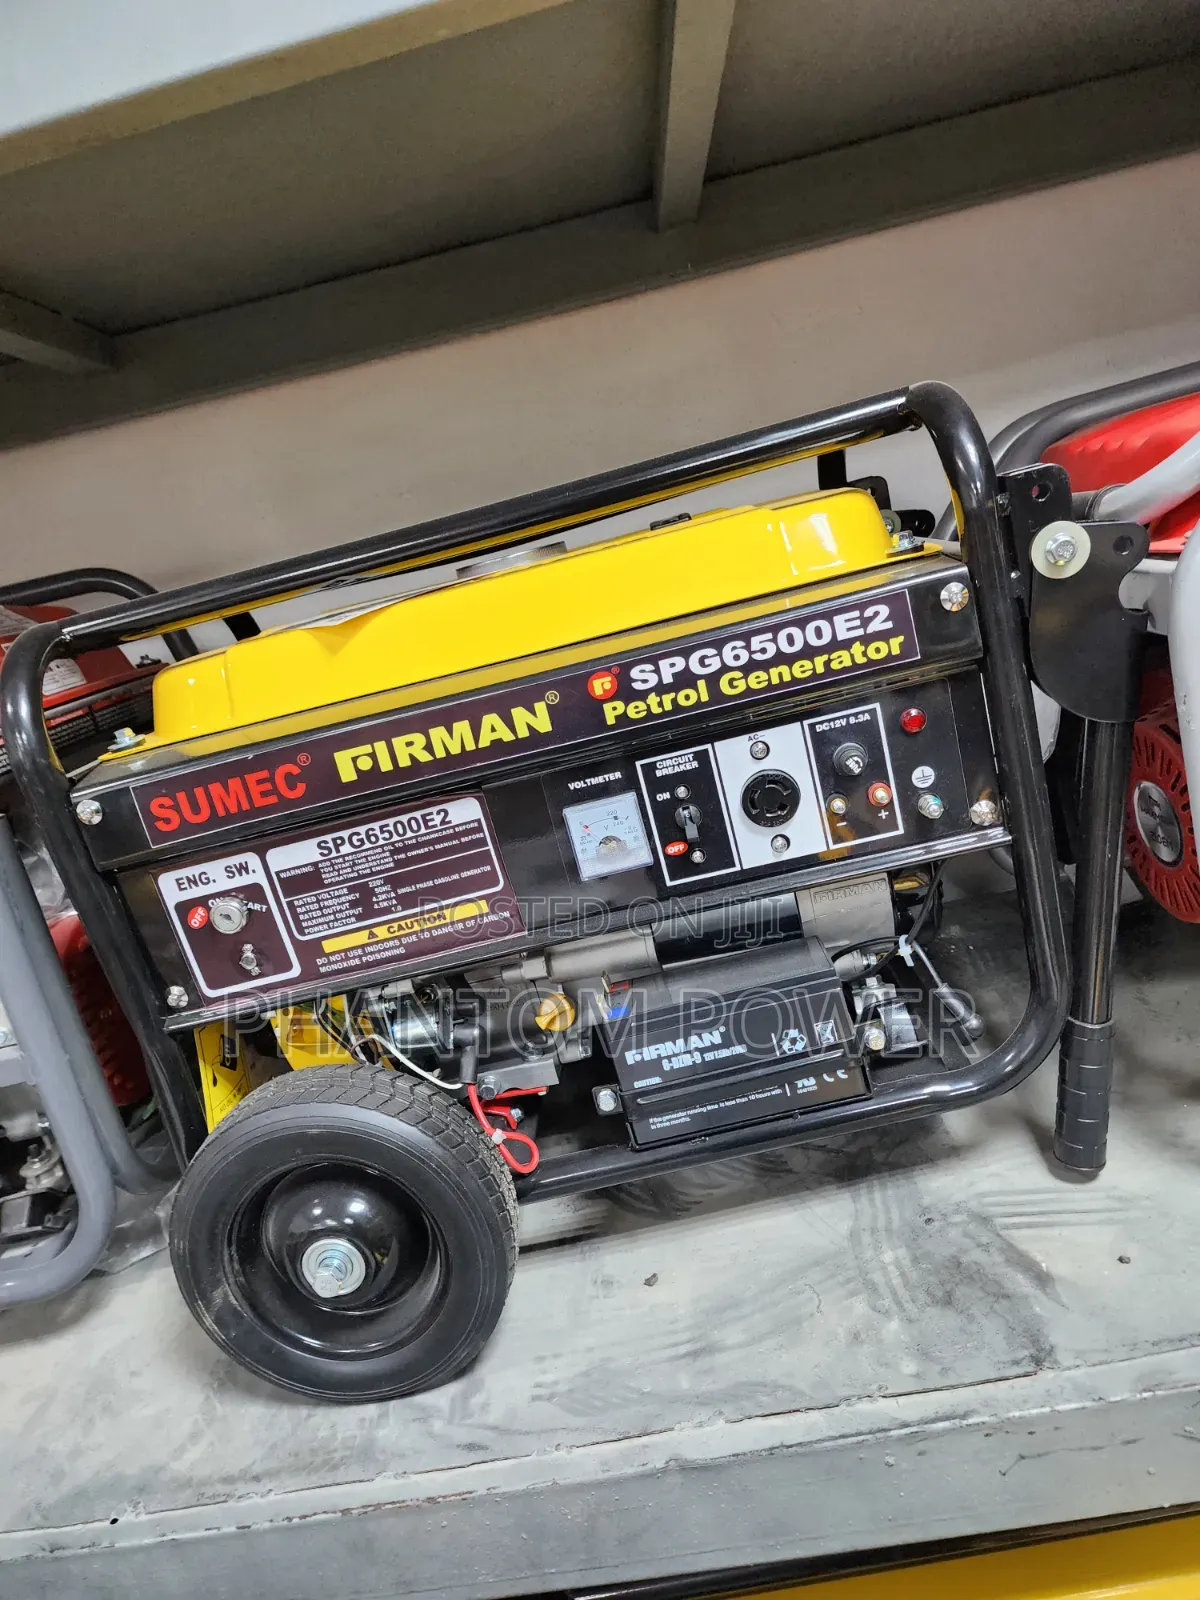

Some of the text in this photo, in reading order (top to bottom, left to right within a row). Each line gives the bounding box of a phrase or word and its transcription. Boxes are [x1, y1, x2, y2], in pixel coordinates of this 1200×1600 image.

[629, 603, 894, 691] SPG6500E2
[602, 635, 905, 726] Petrol Generator
[815, 712, 871, 732] DC12V 8.3A
[655, 760, 699, 777] BREAKER
[656, 753, 694, 769] CIRCUIT
[845, 757, 862, 774] FUSE
[567, 771, 622, 791] VOLTMETER
[656, 791, 671, 802] ON
[316, 808, 453, 858] SPG6500E2
[345, 847, 382, 861] RECOMMEND
[404, 838, 417, 846] THE
[455, 822, 479, 832] BEFORE
[321, 871, 338, 879] READ
[353, 857, 393, 871] UNDERSTAND
[394, 853, 406, 861] THE
[406, 846, 434, 857] OWNER'S
[434, 839, 460, 850] MANUAL
[460, 832, 484, 843] BEFORE
[667, 843, 685, 855] OFF
[279, 865, 316, 879] WARNING:
[334, 862, 353, 870] START
[368, 852, 391, 862] ENGINE
[174, 860, 257, 892] ENG. SW.
[323, 862, 395, 884] OPERATING THE ENGINE
[293, 879, 384, 907] RATED VOLTAGE 220V
[296, 885, 392, 914] RATED FREQUENCY 50HZ
[298, 865, 491, 921] RATED OUTPUT 4.2KVA SINGLE PHASE GASOLINE GENERATOR
[813, 880, 888, 904] FIRMAN
[190, 906, 207, 928] OFF
[301, 914, 335, 928] MAXIMUM
[336, 907, 363, 919] OUTPUT
[304, 905, 402, 935] POWER FACTOR 1.0
[387, 912, 447, 935] CAUTION
[316, 911, 510, 966] DO NOT USE INDOORS DUE TO DANGER OF CARBON
[319, 946, 406, 974] MONOXIDE POISONING
[633, 1076, 662, 1089] CAUTION:
[662, 1112, 687, 1122] generator
[687, 1107, 707, 1116] running
[707, 1103, 719, 1111] time
[724, 1099, 736, 1107] less
[771, 1088, 783, 1096] with
[657, 1121, 671, 1129] three
